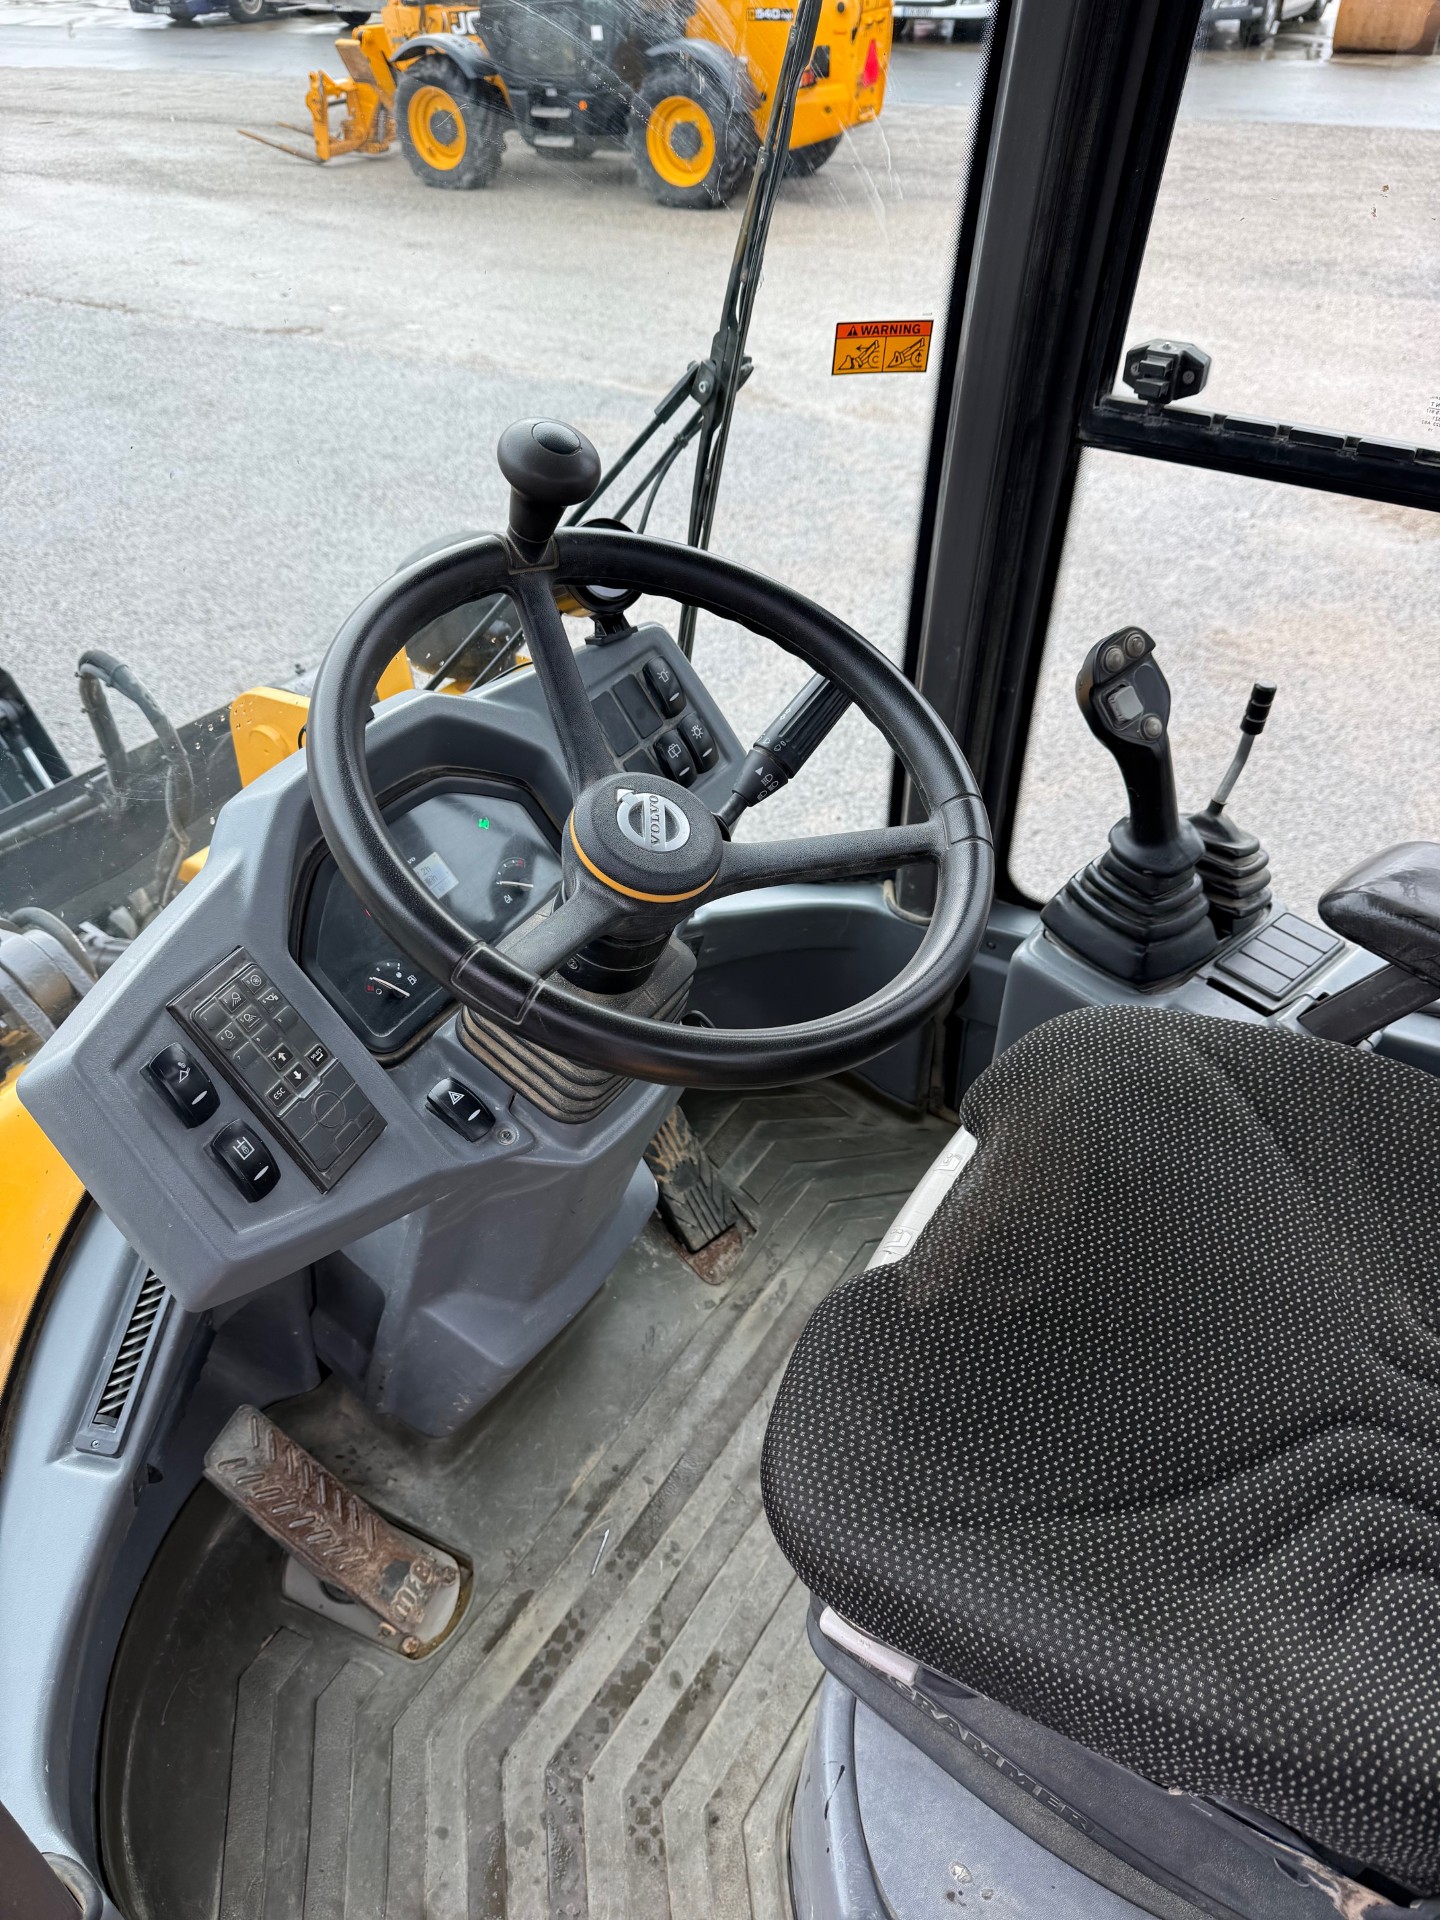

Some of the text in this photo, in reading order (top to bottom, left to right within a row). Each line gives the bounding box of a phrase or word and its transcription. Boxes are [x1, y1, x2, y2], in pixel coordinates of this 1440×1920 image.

[860, 323, 921, 336] WARNING
[648, 794, 661, 846] VOLVO
[310, 1047, 323, 1060] SELECT
[273, 1087, 286, 1100] ESC
[887, 1675, 1096, 1834] GRAMMER
